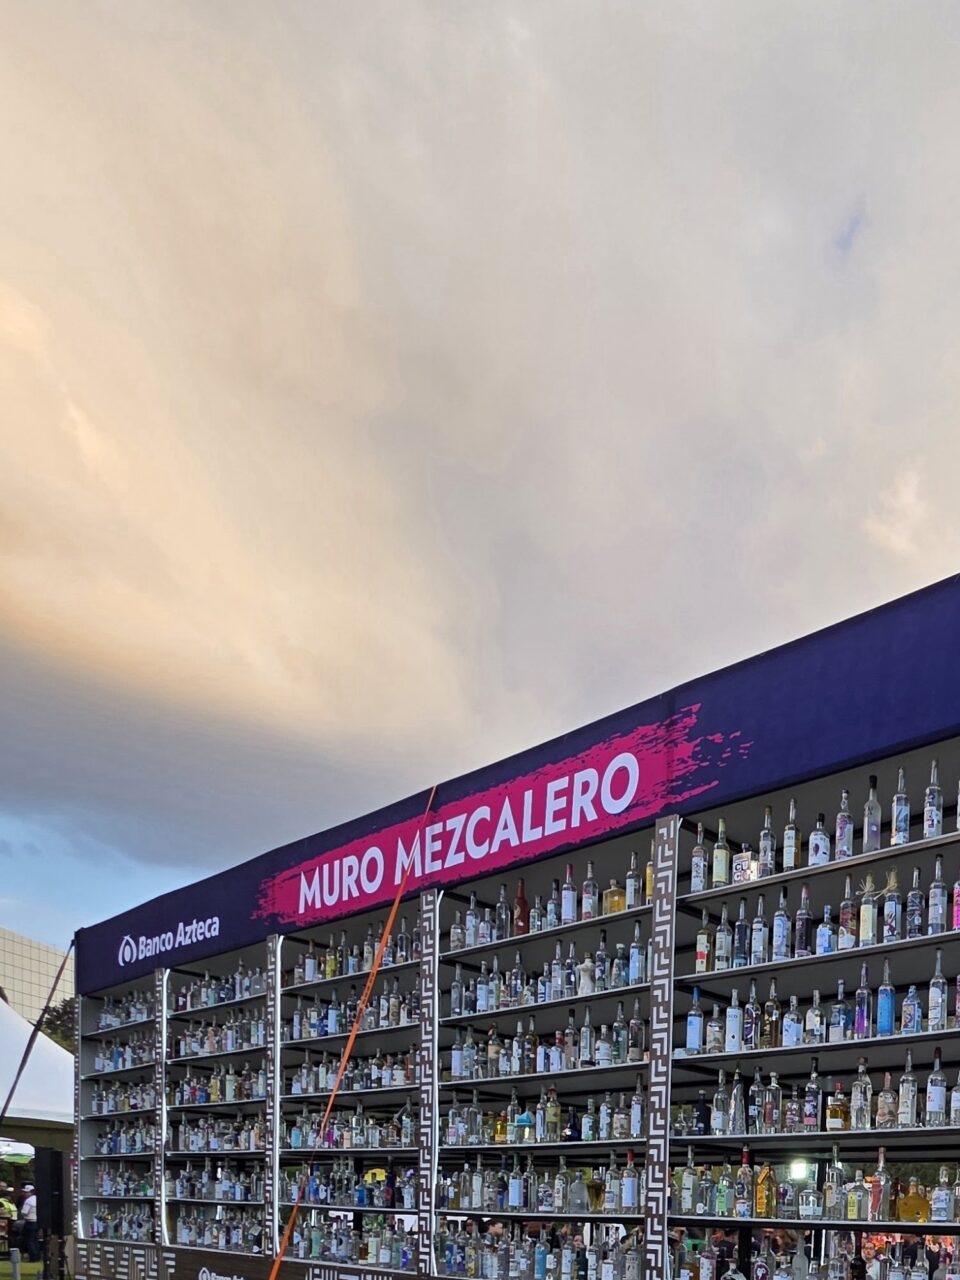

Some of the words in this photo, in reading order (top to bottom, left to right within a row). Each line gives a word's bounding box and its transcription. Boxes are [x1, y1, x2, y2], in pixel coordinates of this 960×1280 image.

[298, 846, 385, 914] MURO
[394, 752, 640, 886] MEZCALERO
[138, 932, 174, 960] Banco
[175, 916, 220, 948] Azteca
